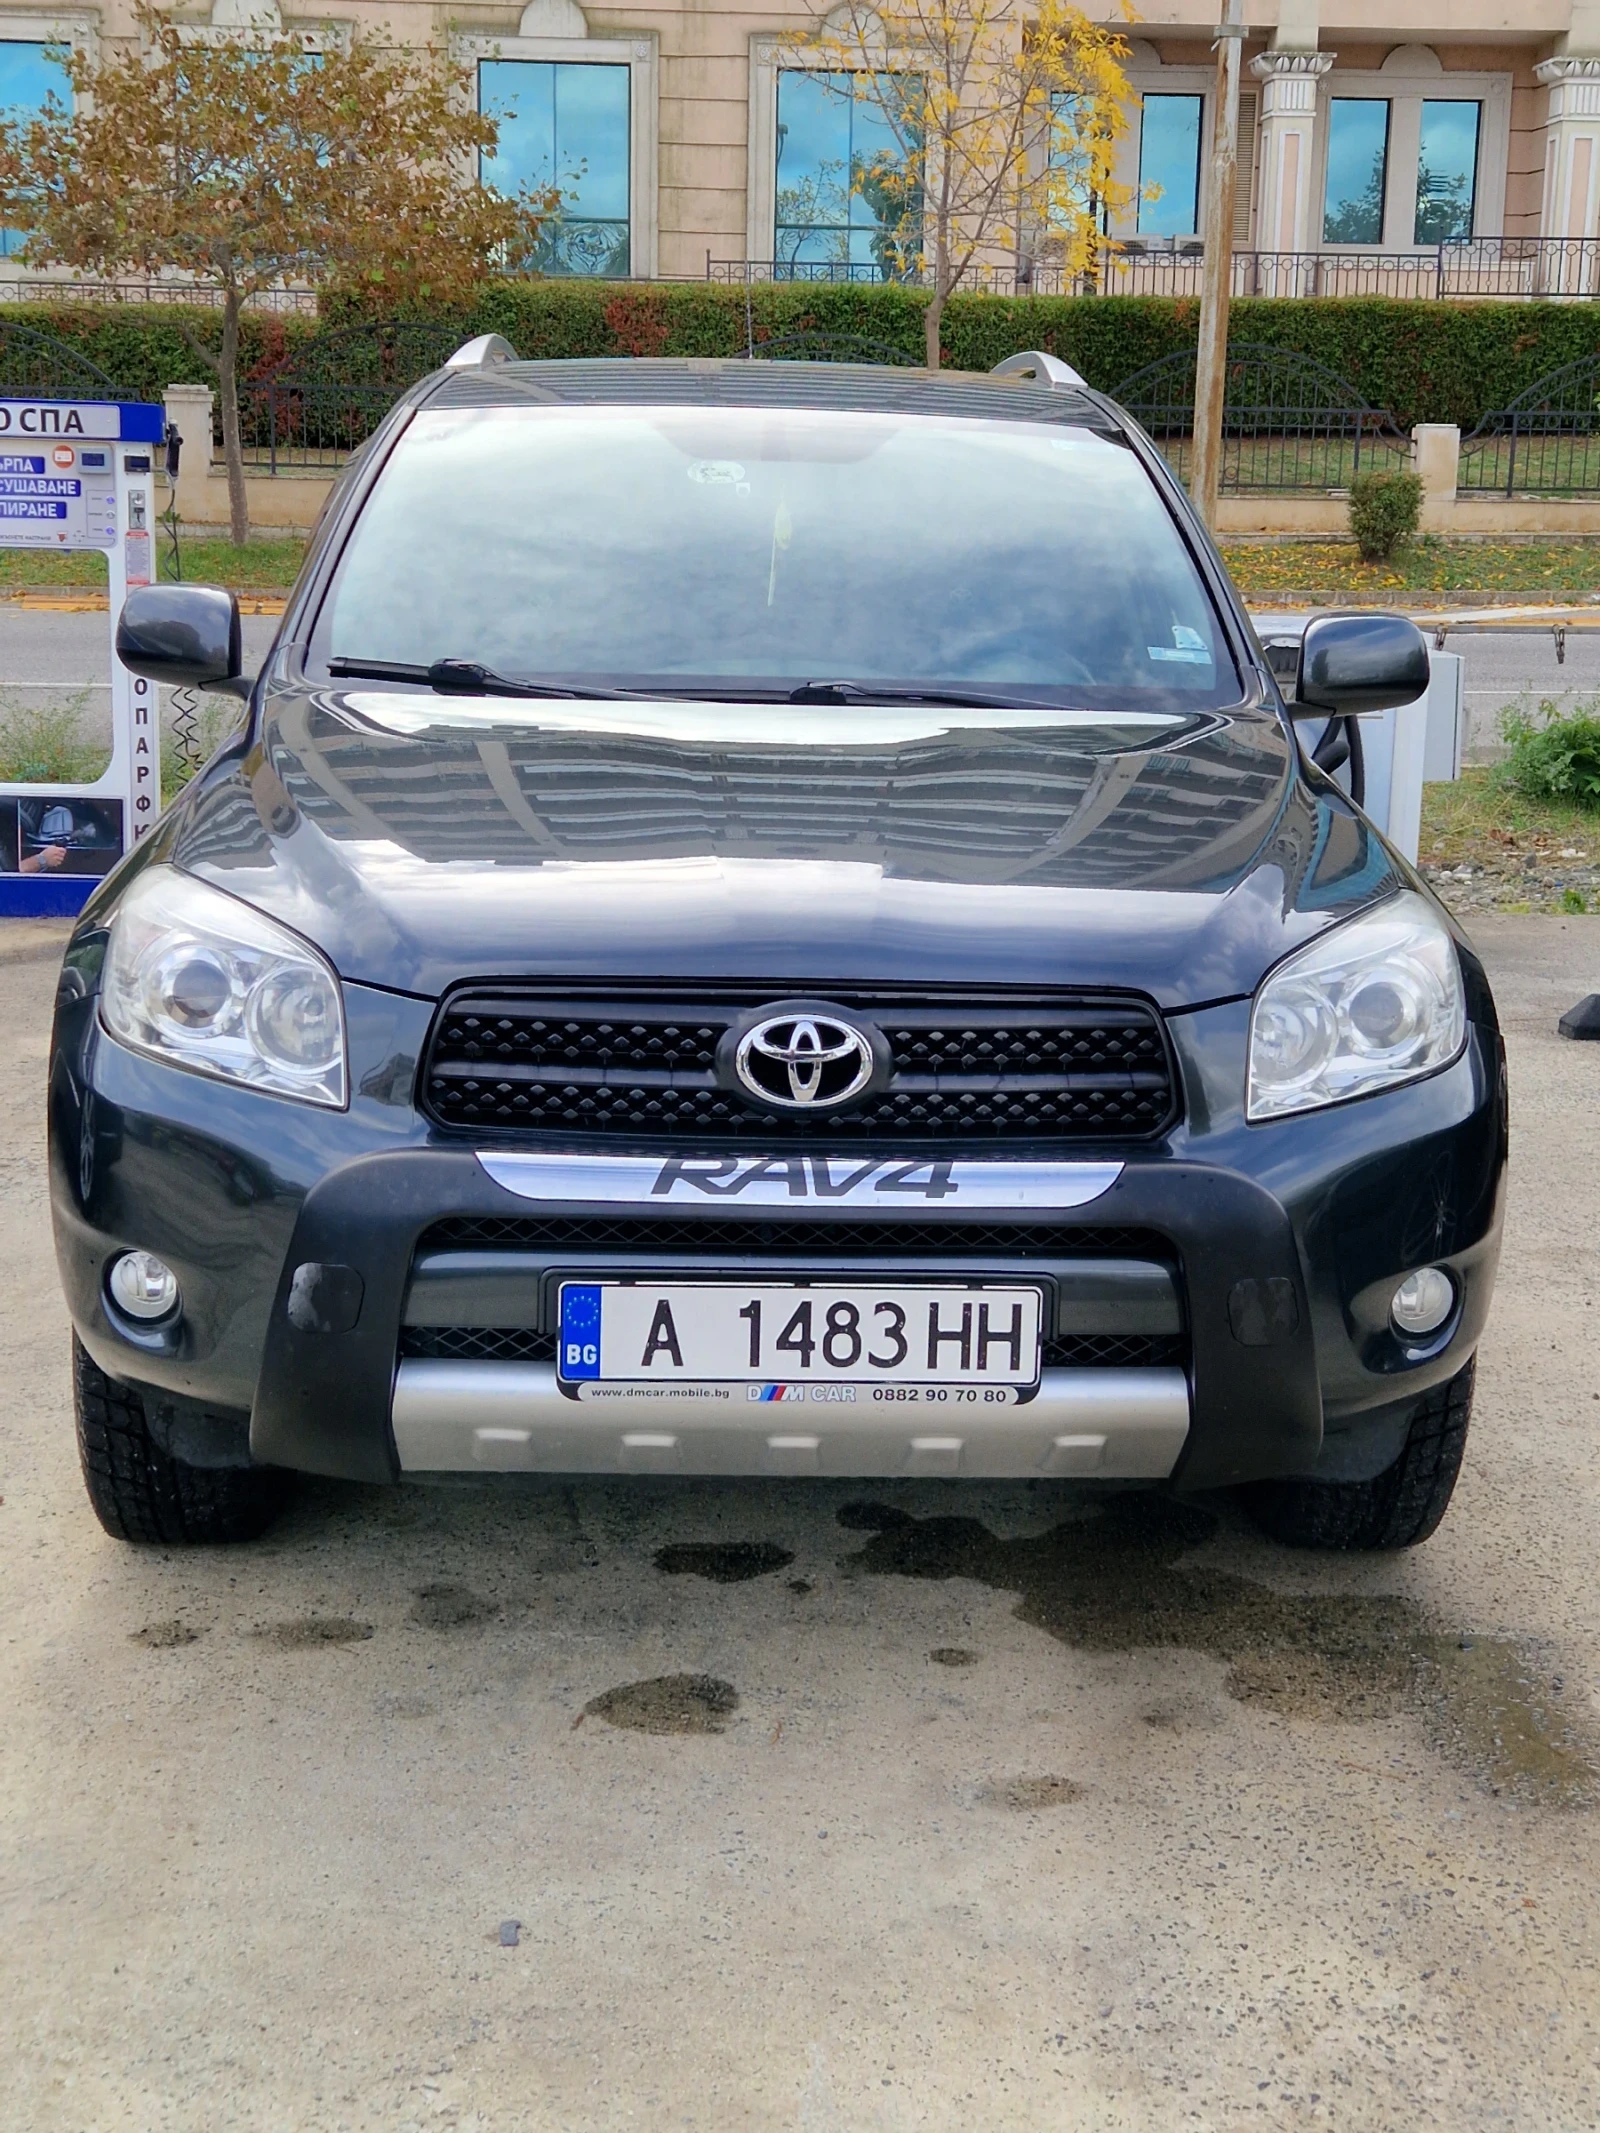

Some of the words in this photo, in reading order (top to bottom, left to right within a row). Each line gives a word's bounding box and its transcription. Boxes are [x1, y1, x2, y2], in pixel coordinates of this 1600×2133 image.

[20, 408, 84, 433] СПА
[651, 1157, 958, 1198] RAV4
[641, 1299, 684, 1366] A
[566, 1344, 597, 1365] BG
[591, 1387, 730, 1399] www.dmcar.mobile.bg
[811, 1385, 856, 1403] CAR
[872, 1389, 919, 1401] 0882
[925, 1390, 947, 1402] 90
[955, 1390, 977, 1402] 70
[983, 1390, 1006, 1402] 80
